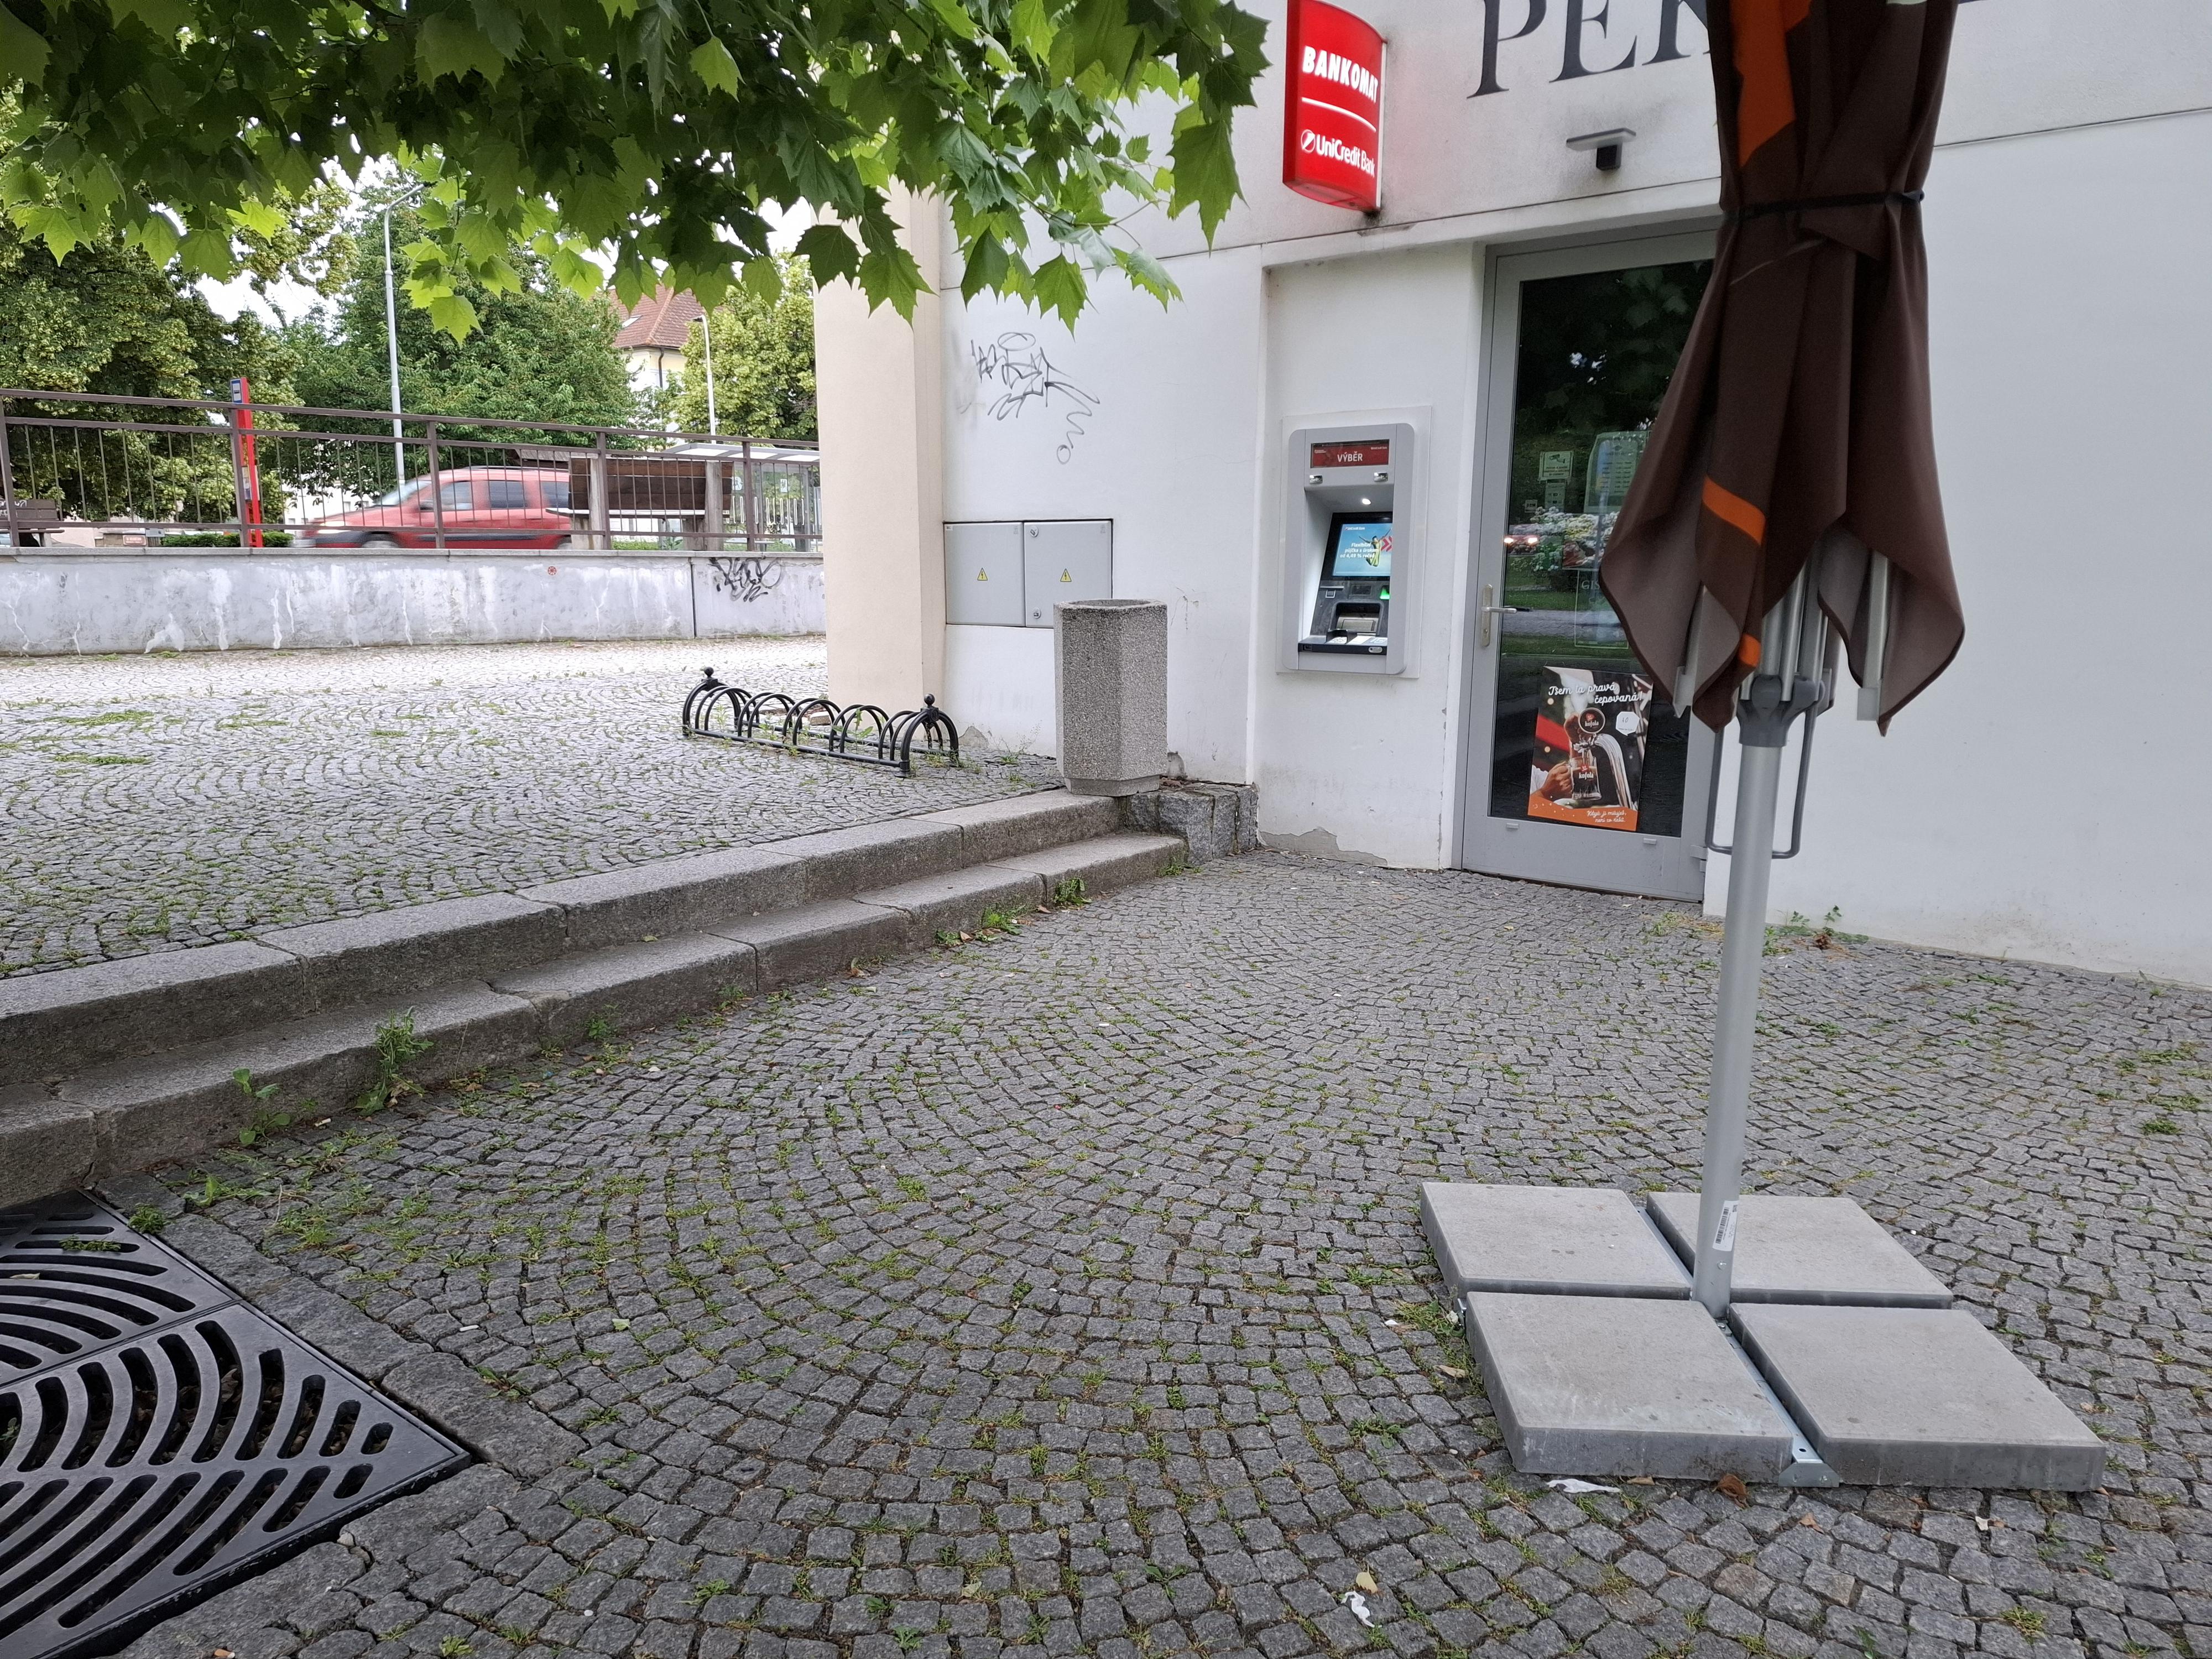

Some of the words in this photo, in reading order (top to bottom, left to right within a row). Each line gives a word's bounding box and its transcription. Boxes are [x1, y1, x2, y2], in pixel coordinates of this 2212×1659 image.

[1302, 45, 1379, 104] BANKOMAT
[1316, 134, 1360, 169] UniCredit
[1361, 150, 1375, 178] Bank
[1337, 451, 1363, 462] VÝBĚR
[1548, 686, 1572, 695] Jsem
[1594, 690, 1643, 706] čepovaná!
[1579, 771, 1594, 780] kofola
